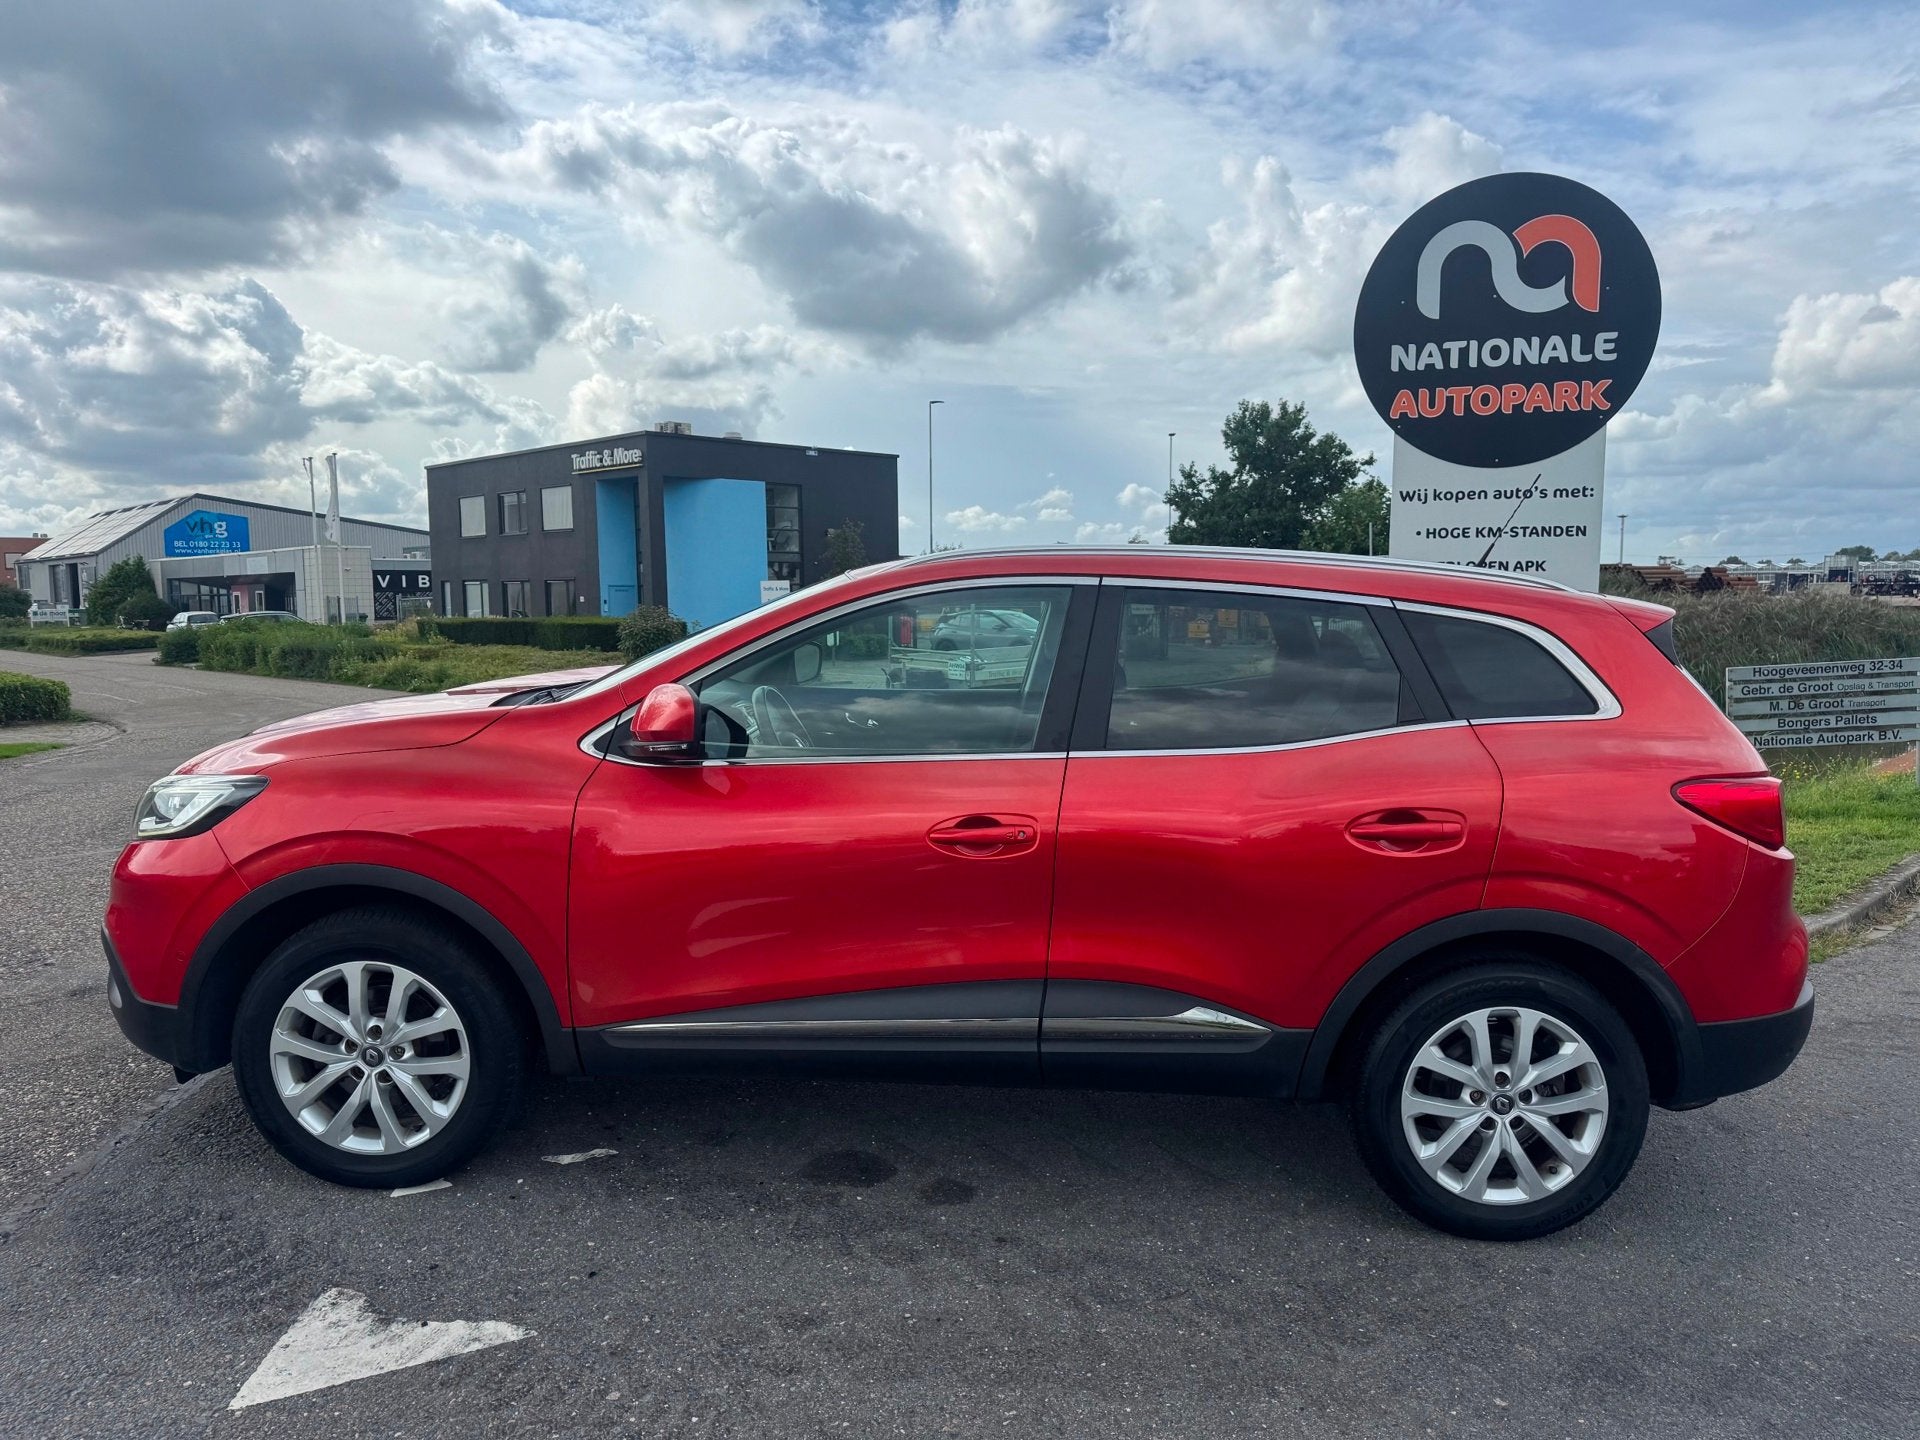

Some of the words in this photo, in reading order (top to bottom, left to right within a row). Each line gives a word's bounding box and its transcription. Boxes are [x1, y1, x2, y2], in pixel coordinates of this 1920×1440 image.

[1390, 331, 1619, 372] NATIONALE
[1389, 379, 1613, 419] AUTOPARK
[571, 450, 602, 470] Traffic
[603, 449, 613, 467] &
[613, 447, 643, 465] More
[1399, 489, 1428, 504] Wij
[1433, 488, 1488, 503] kopen
[1553, 485, 1595, 498] met:
[185, 517, 228, 538] vhg
[1426, 527, 1471, 539] HOGE
[1475, 525, 1587, 539] KM-STANDEN
[1513, 560, 1547, 572] APK
[1752, 662, 1866, 679] Hoogeveenenweg
[1869, 660, 1904, 672] 32-34
[1741, 684, 1775, 696] Gebr.
[1778, 683, 1794, 694] de
[1797, 681, 1834, 693] Groot
[1837, 682, 1865, 692] Opslag
[1867, 681, 1874, 690] &
[1876, 680, 1914, 690] Transport
[1769, 701, 1784, 712] M.
[1788, 699, 1804, 710] De
[1808, 698, 1844, 710] Groot
[1848, 698, 1886, 709] Transport
[1777, 717, 1831, 730] Bongers
[1835, 714, 1878, 726] Pallets
[1753, 735, 1814, 747] Nationale
[1817, 733, 1875, 745] Autopark
[1878, 730, 1902, 741] B.V.
